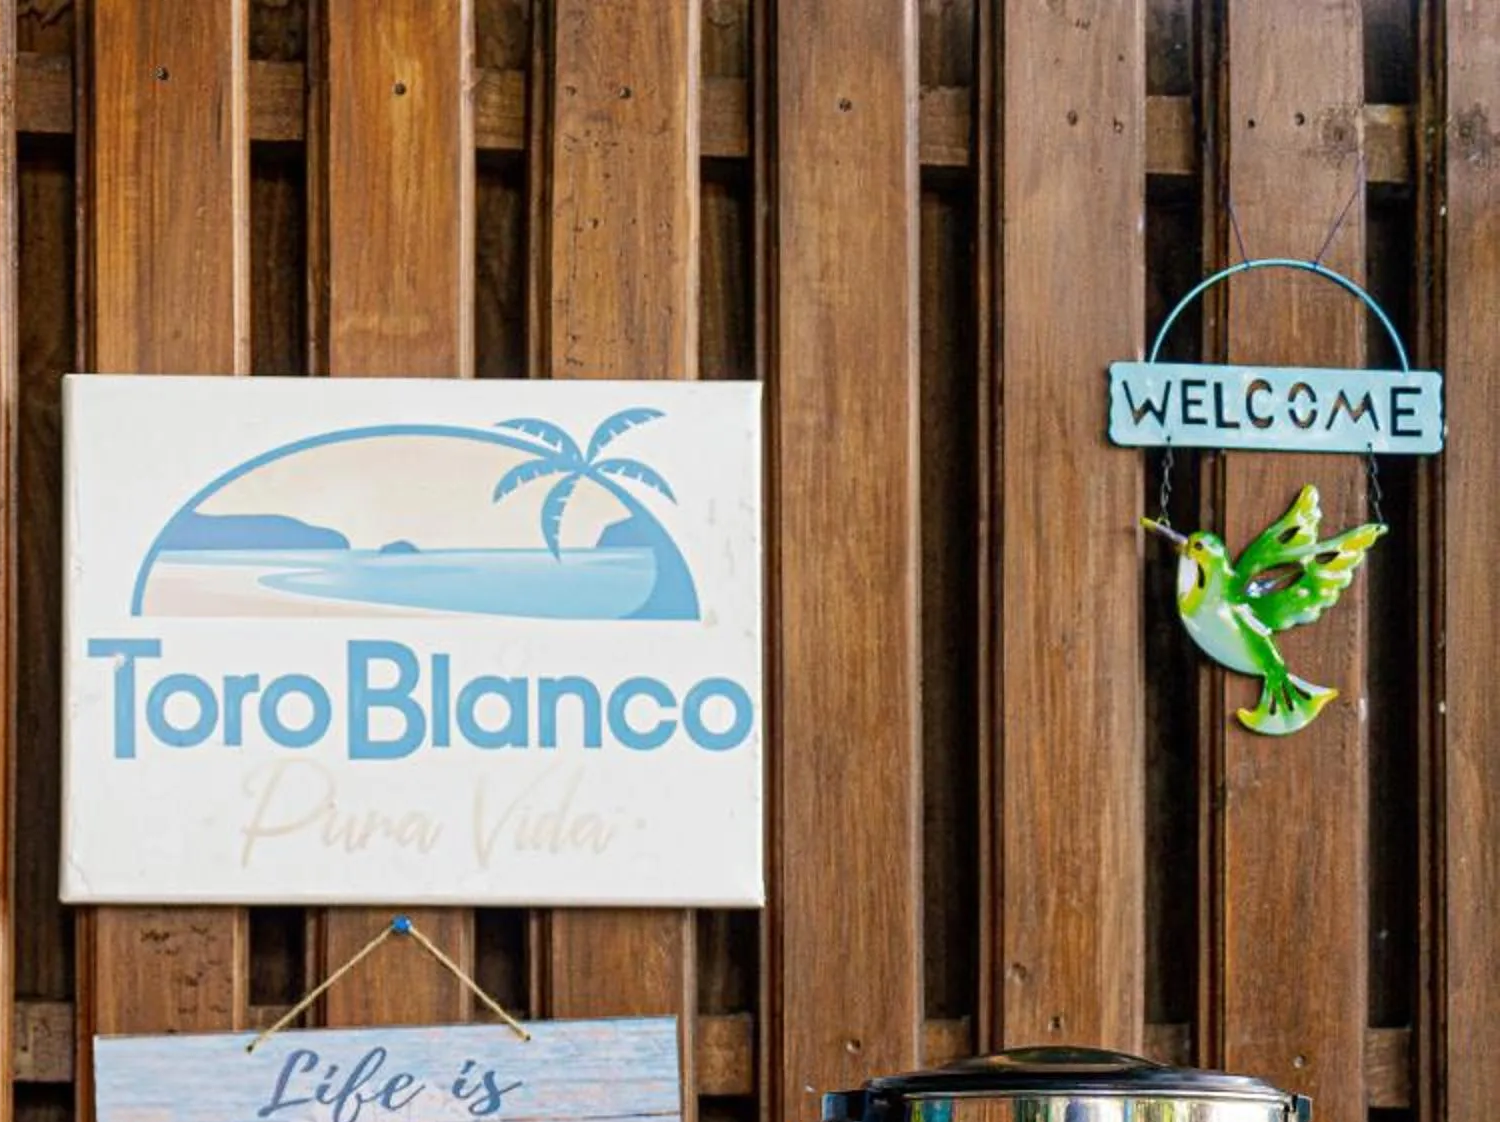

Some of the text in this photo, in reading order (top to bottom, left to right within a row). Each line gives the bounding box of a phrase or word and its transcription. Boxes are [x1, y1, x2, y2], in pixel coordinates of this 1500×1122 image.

[1122, 378, 1423, 437] WELCOME
[241, 755, 617, 870] Pura Vida
[452, 1059, 523, 1117] is
